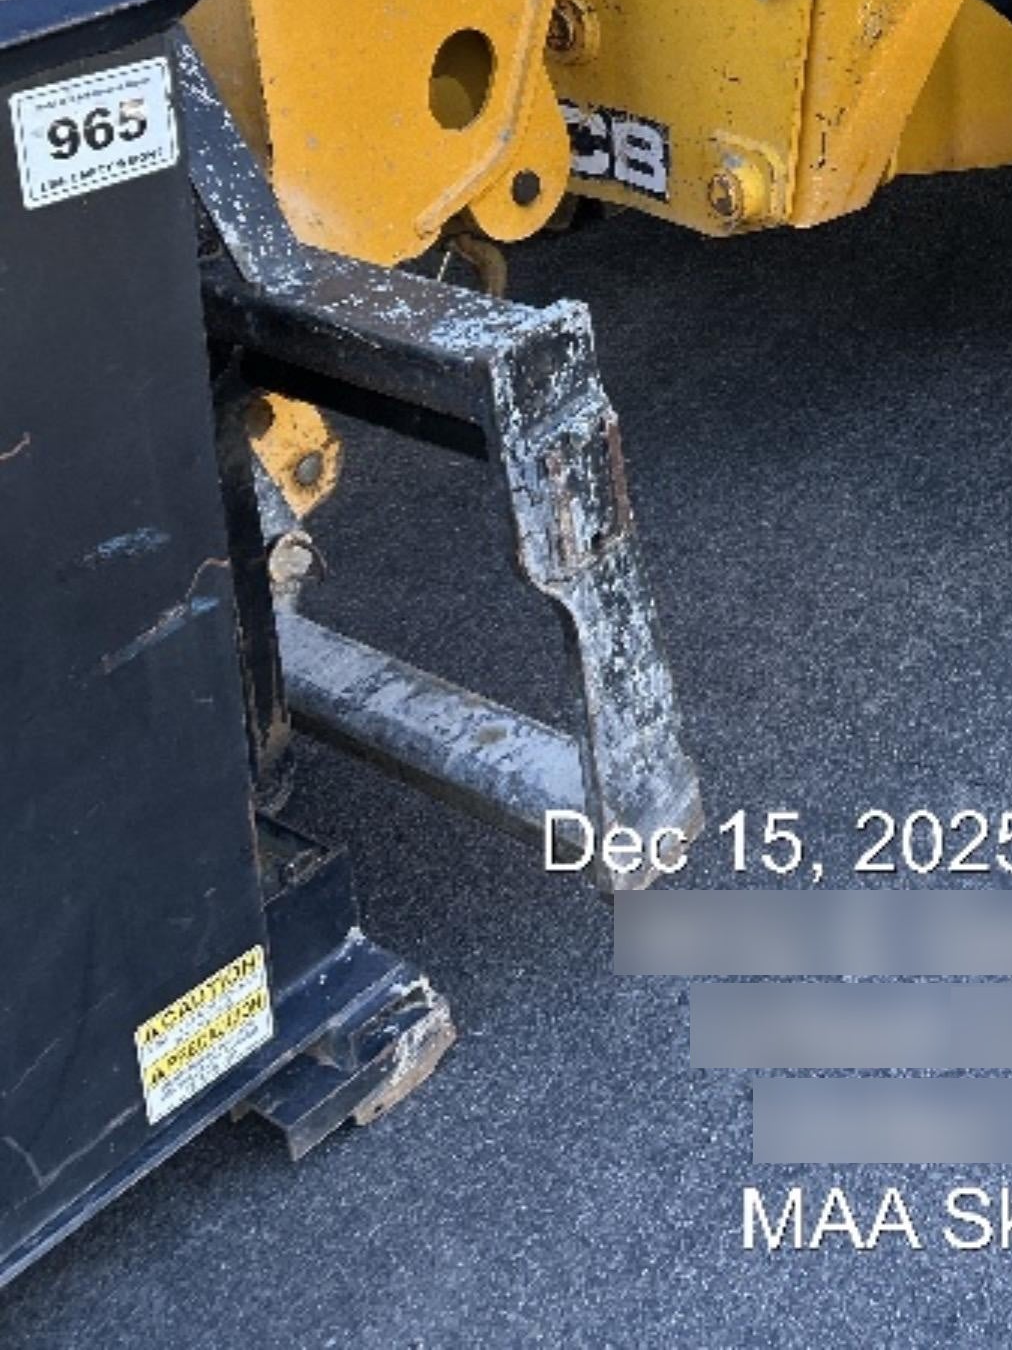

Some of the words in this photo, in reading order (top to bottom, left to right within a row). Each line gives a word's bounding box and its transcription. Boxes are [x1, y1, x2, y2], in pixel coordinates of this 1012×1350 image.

[47, 98, 149, 160] 965
[558, 103, 668, 193] CB
[160, 953, 257, 1028] CAUTION
